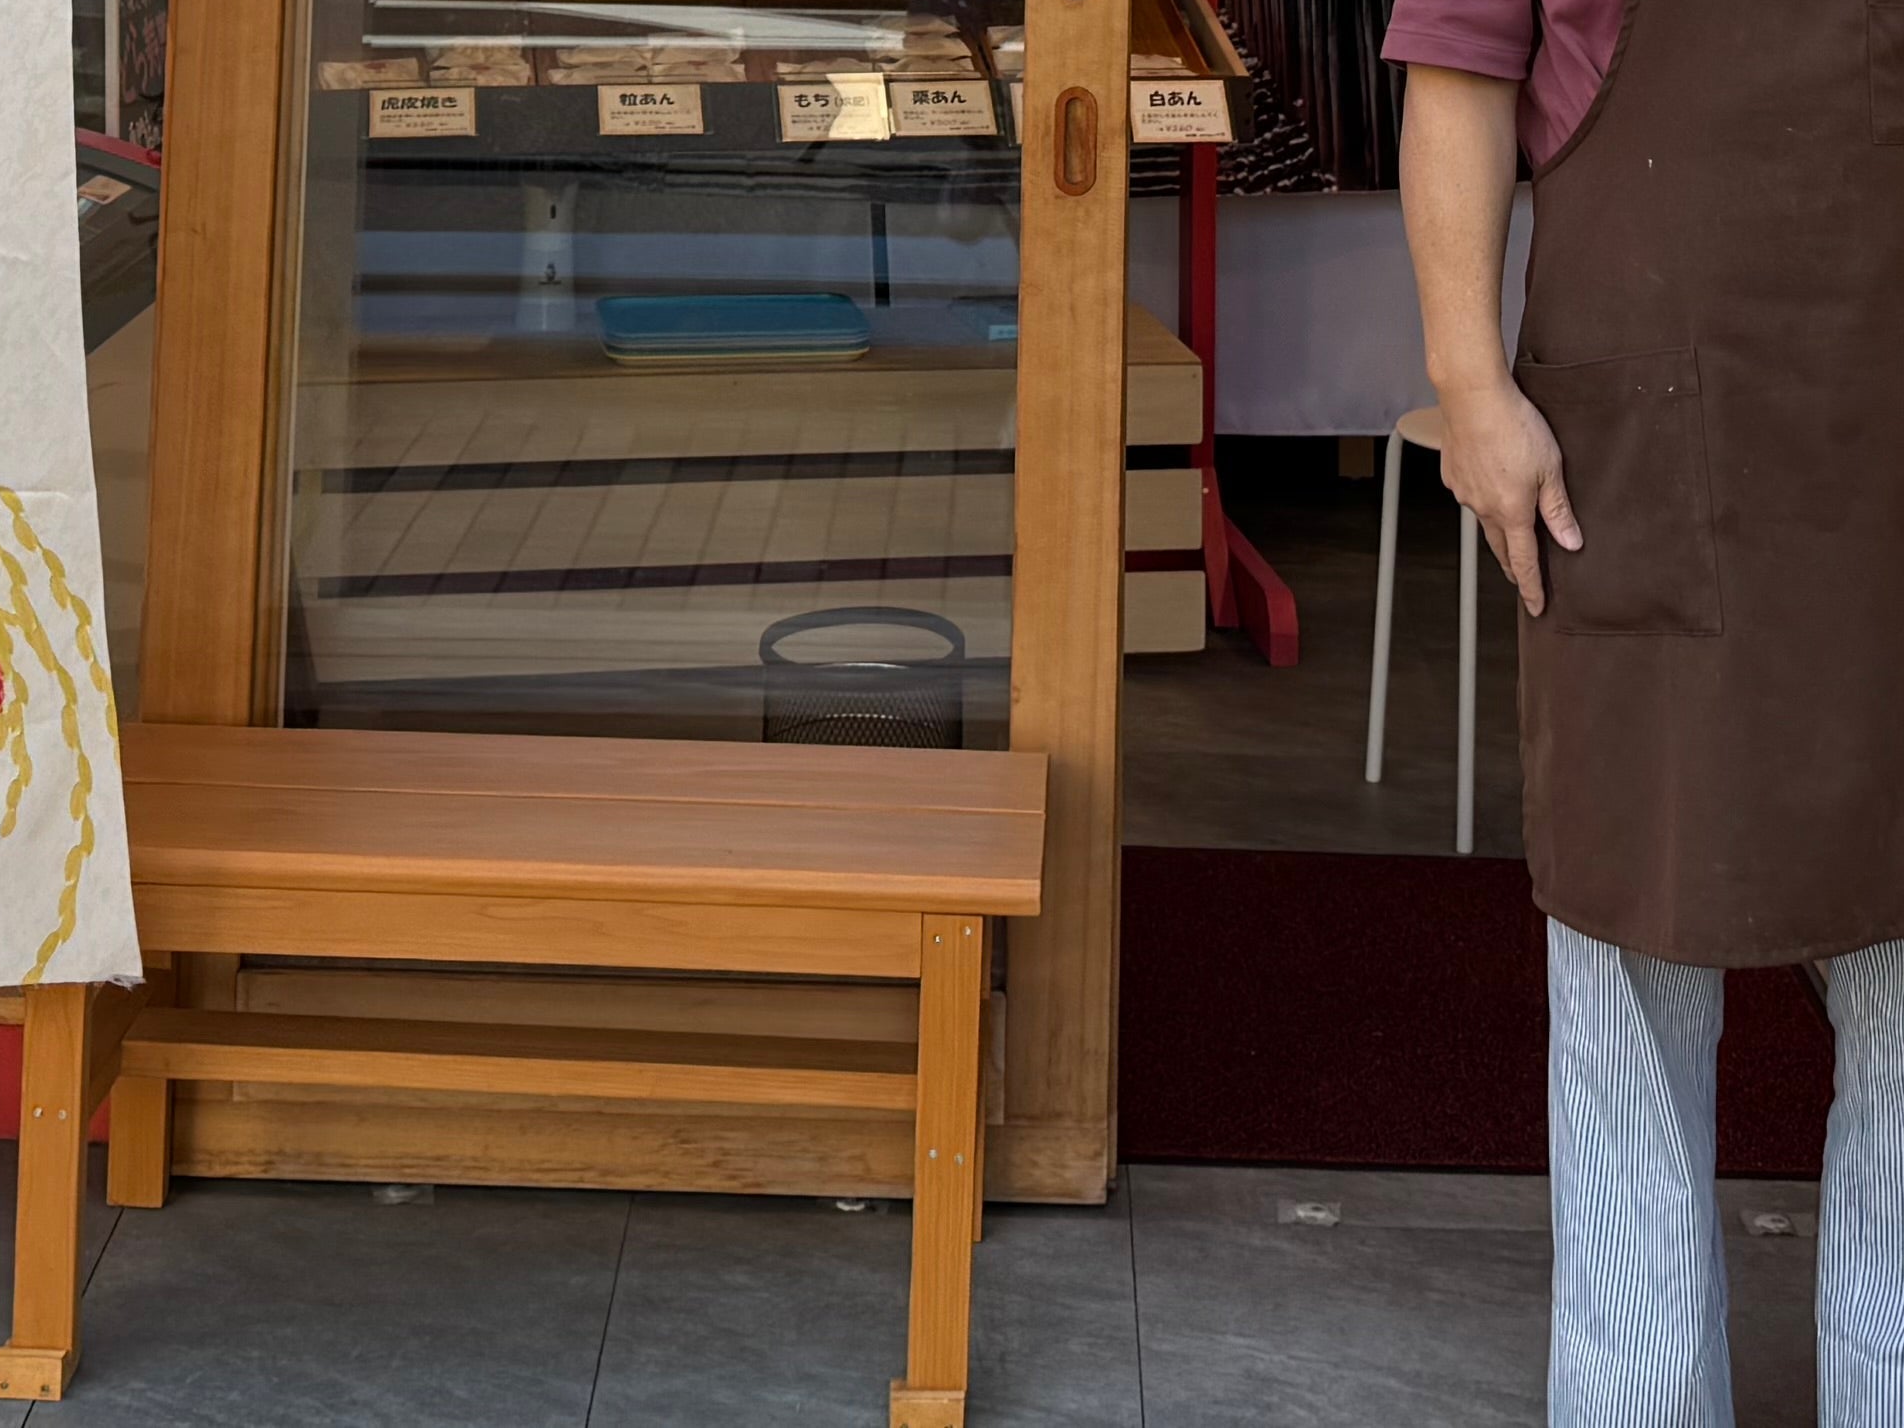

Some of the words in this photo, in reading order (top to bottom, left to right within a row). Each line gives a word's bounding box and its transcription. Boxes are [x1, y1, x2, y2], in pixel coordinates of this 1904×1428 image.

[619, 93, 675, 106] 粒あん
[912, 90, 967, 105] 栗あん
[1149, 90, 1202, 107] 白あん
